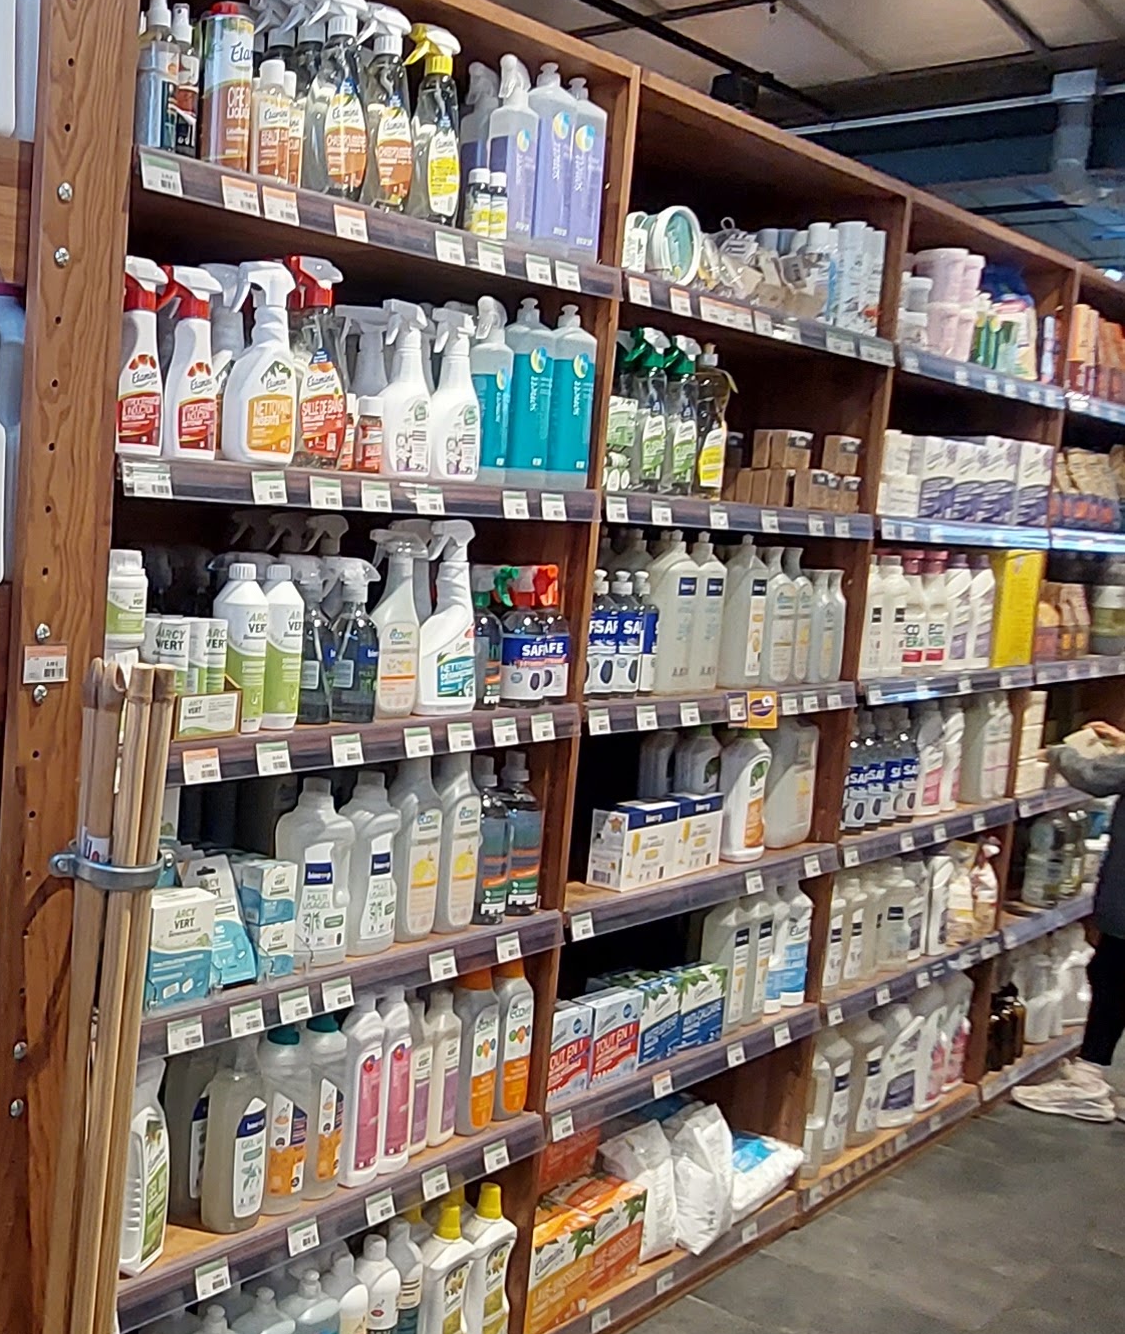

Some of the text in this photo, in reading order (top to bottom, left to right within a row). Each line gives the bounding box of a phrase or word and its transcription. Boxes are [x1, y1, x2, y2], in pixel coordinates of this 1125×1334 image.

[302, 401, 320, 415] SALLE
[596, 620, 617, 634] SAF
[176, 907, 196, 918] ARCY
[174, 918, 195, 929] VERT
[596, 1033, 616, 1053] TOUT
[549, 1050, 566, 1070] OUT
